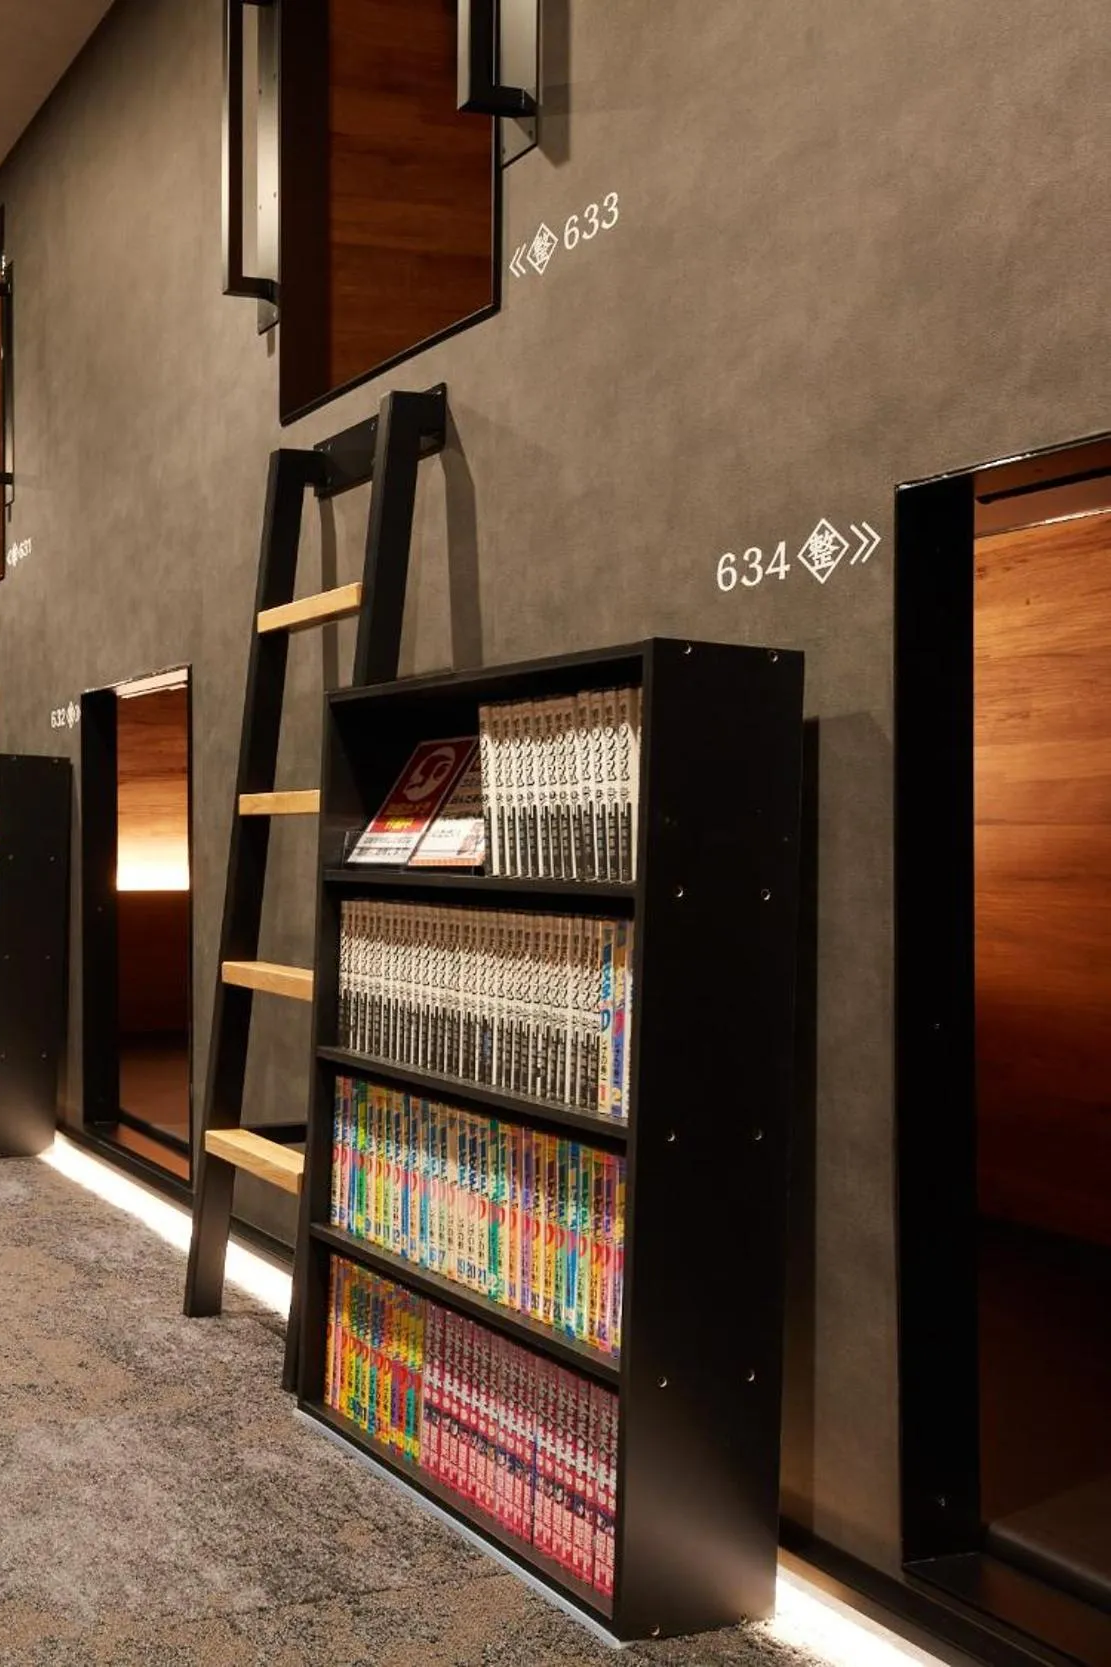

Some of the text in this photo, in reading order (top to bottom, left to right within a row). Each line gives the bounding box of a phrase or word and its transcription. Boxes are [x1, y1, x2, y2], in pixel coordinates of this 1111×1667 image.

[563, 191, 620, 250] 633
[716, 540, 791, 592] 634
[50, 709, 66, 729] 632
